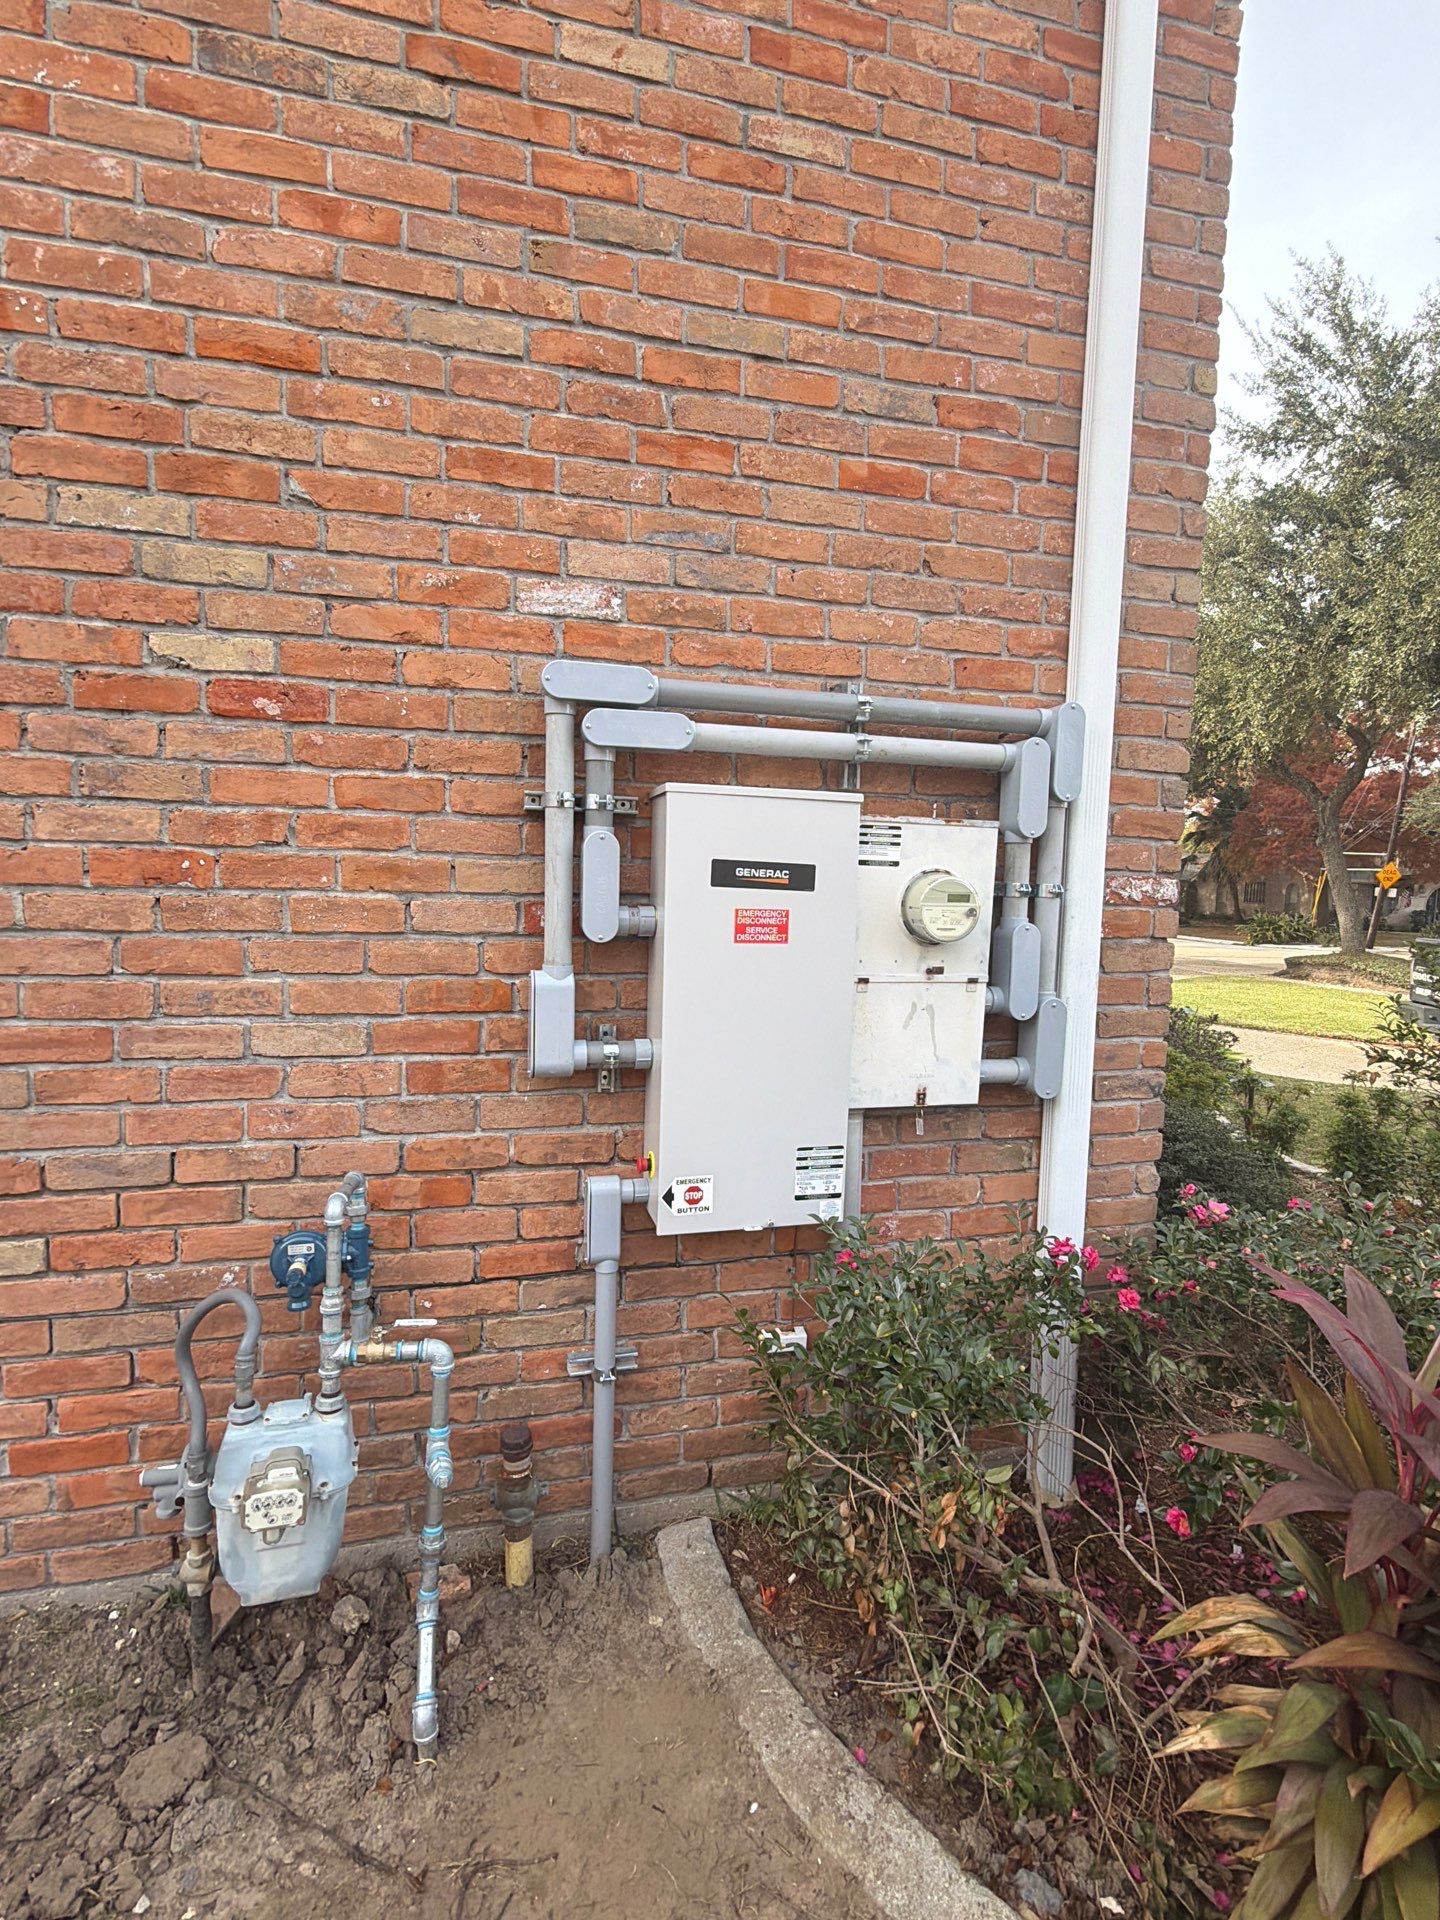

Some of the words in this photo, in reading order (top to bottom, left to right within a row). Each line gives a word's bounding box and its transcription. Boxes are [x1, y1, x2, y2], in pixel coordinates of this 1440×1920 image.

[735, 867, 790, 879] GENERAC
[738, 909, 787, 917] EMERGENCY
[737, 917, 787, 925] DISCONNECT
[745, 926, 779, 934] SERVICE
[736, 933, 787, 942] DISCONNECT
[676, 1177, 711, 1185] EMERGENCY
[685, 1191, 703, 1200] STOP
[677, 1206, 710, 1214] BUTTON
